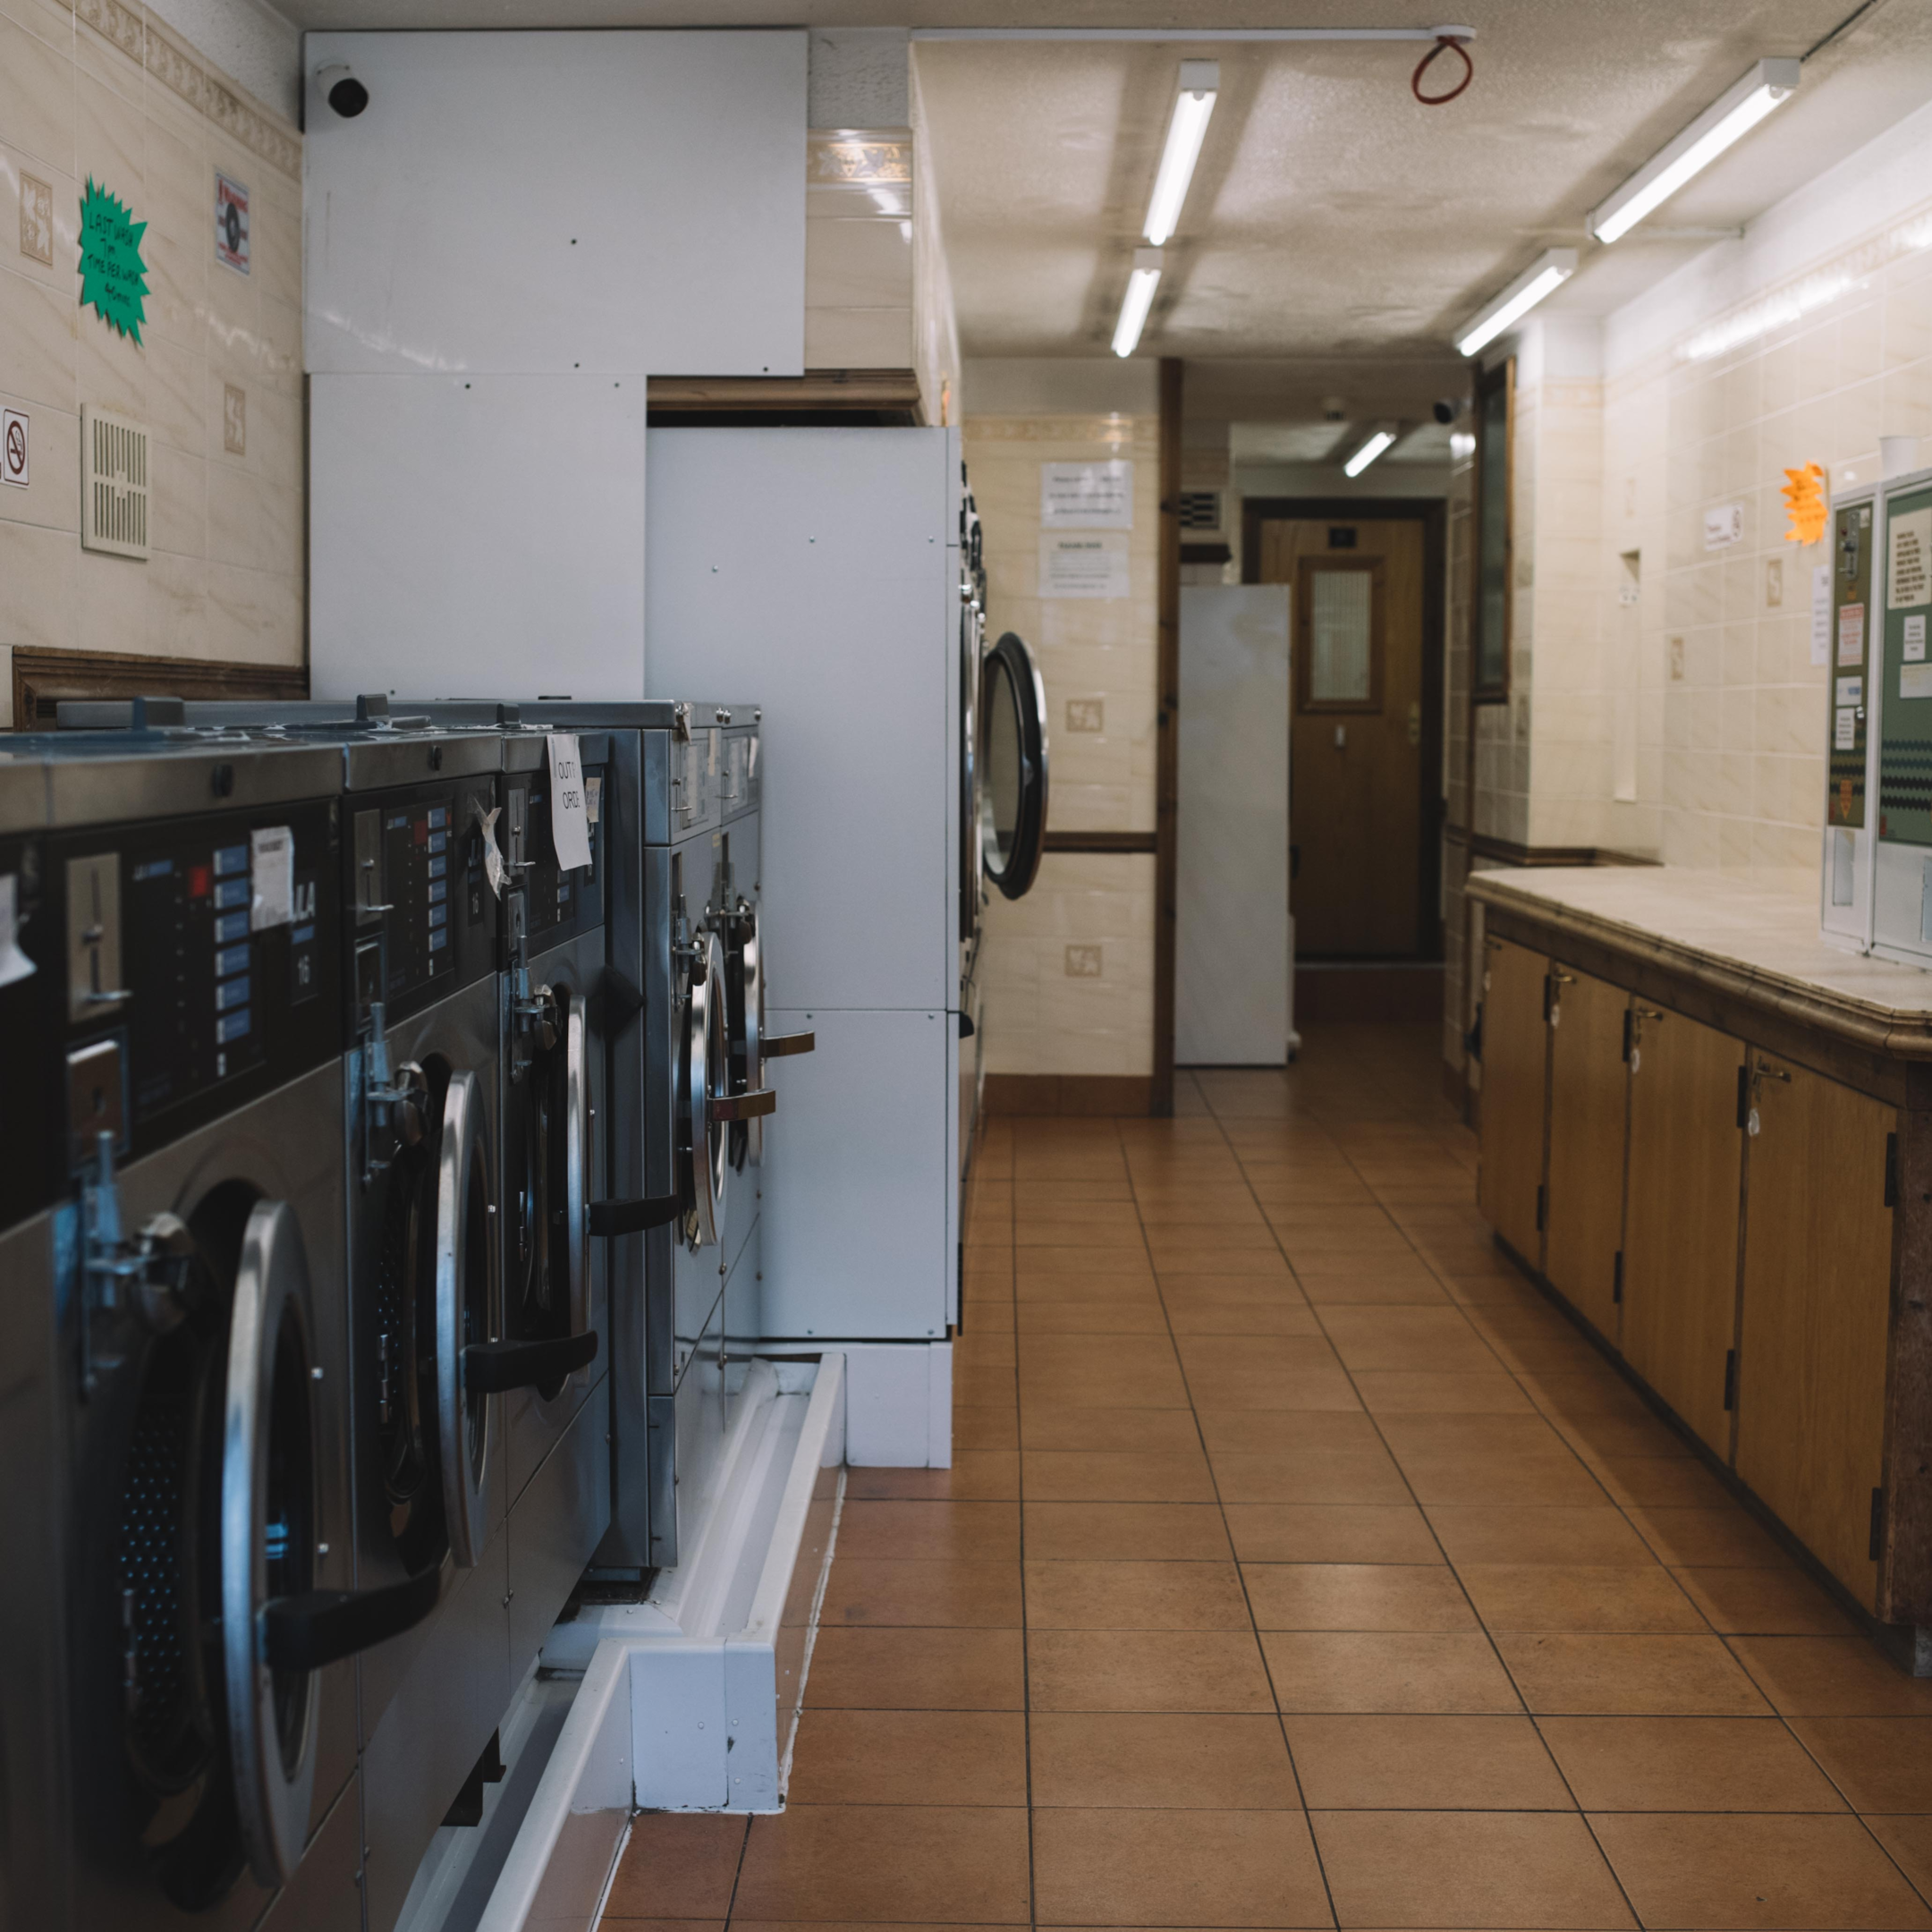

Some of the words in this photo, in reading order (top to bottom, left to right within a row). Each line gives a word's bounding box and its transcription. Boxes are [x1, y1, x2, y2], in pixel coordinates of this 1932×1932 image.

[89, 211, 114, 236] LAST
[88, 254, 106, 274] TIME
[106, 261, 121, 280] PER
[558, 761, 572, 779] OUT
[472, 892, 479, 914] 16
[298, 954, 310, 985] 16
